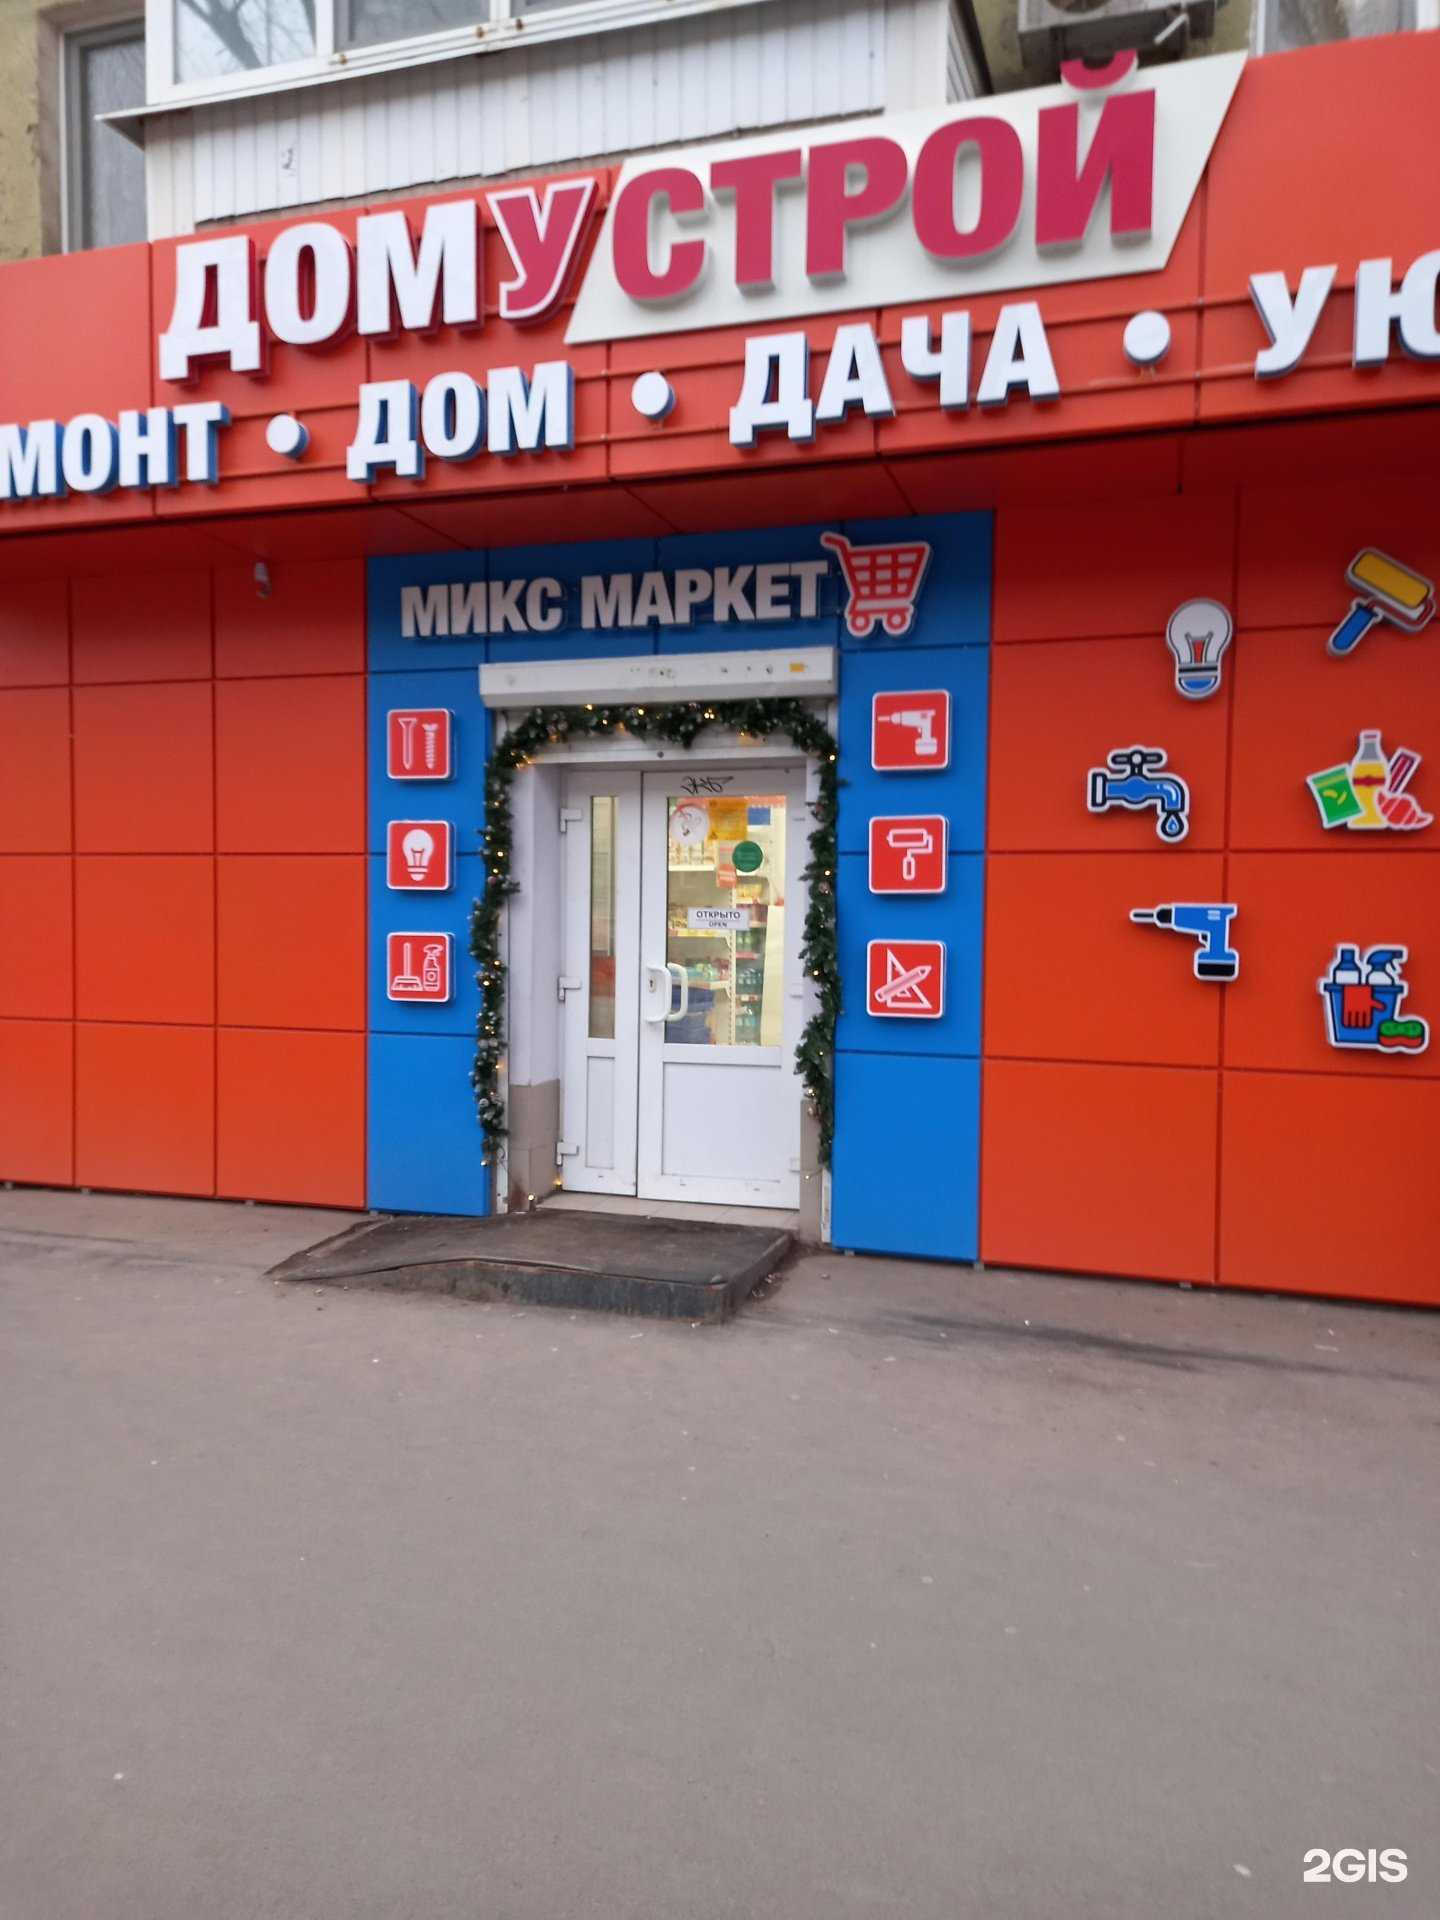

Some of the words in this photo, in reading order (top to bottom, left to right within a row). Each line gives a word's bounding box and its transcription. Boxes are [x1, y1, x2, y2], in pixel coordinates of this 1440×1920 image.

[159, 50, 1157, 382] ДОМУСТРОЙ
[0, 401, 224, 500] МОНТ
[347, 360, 574, 482] ДОМ
[729, 302, 1061, 447] ДАЧА
[401, 576, 563, 638] МИКС
[580, 560, 829, 630] МАРКЕТ
[695, 910, 741, 920] ОТКРЫТО
[708, 920, 728, 928] OPEN
